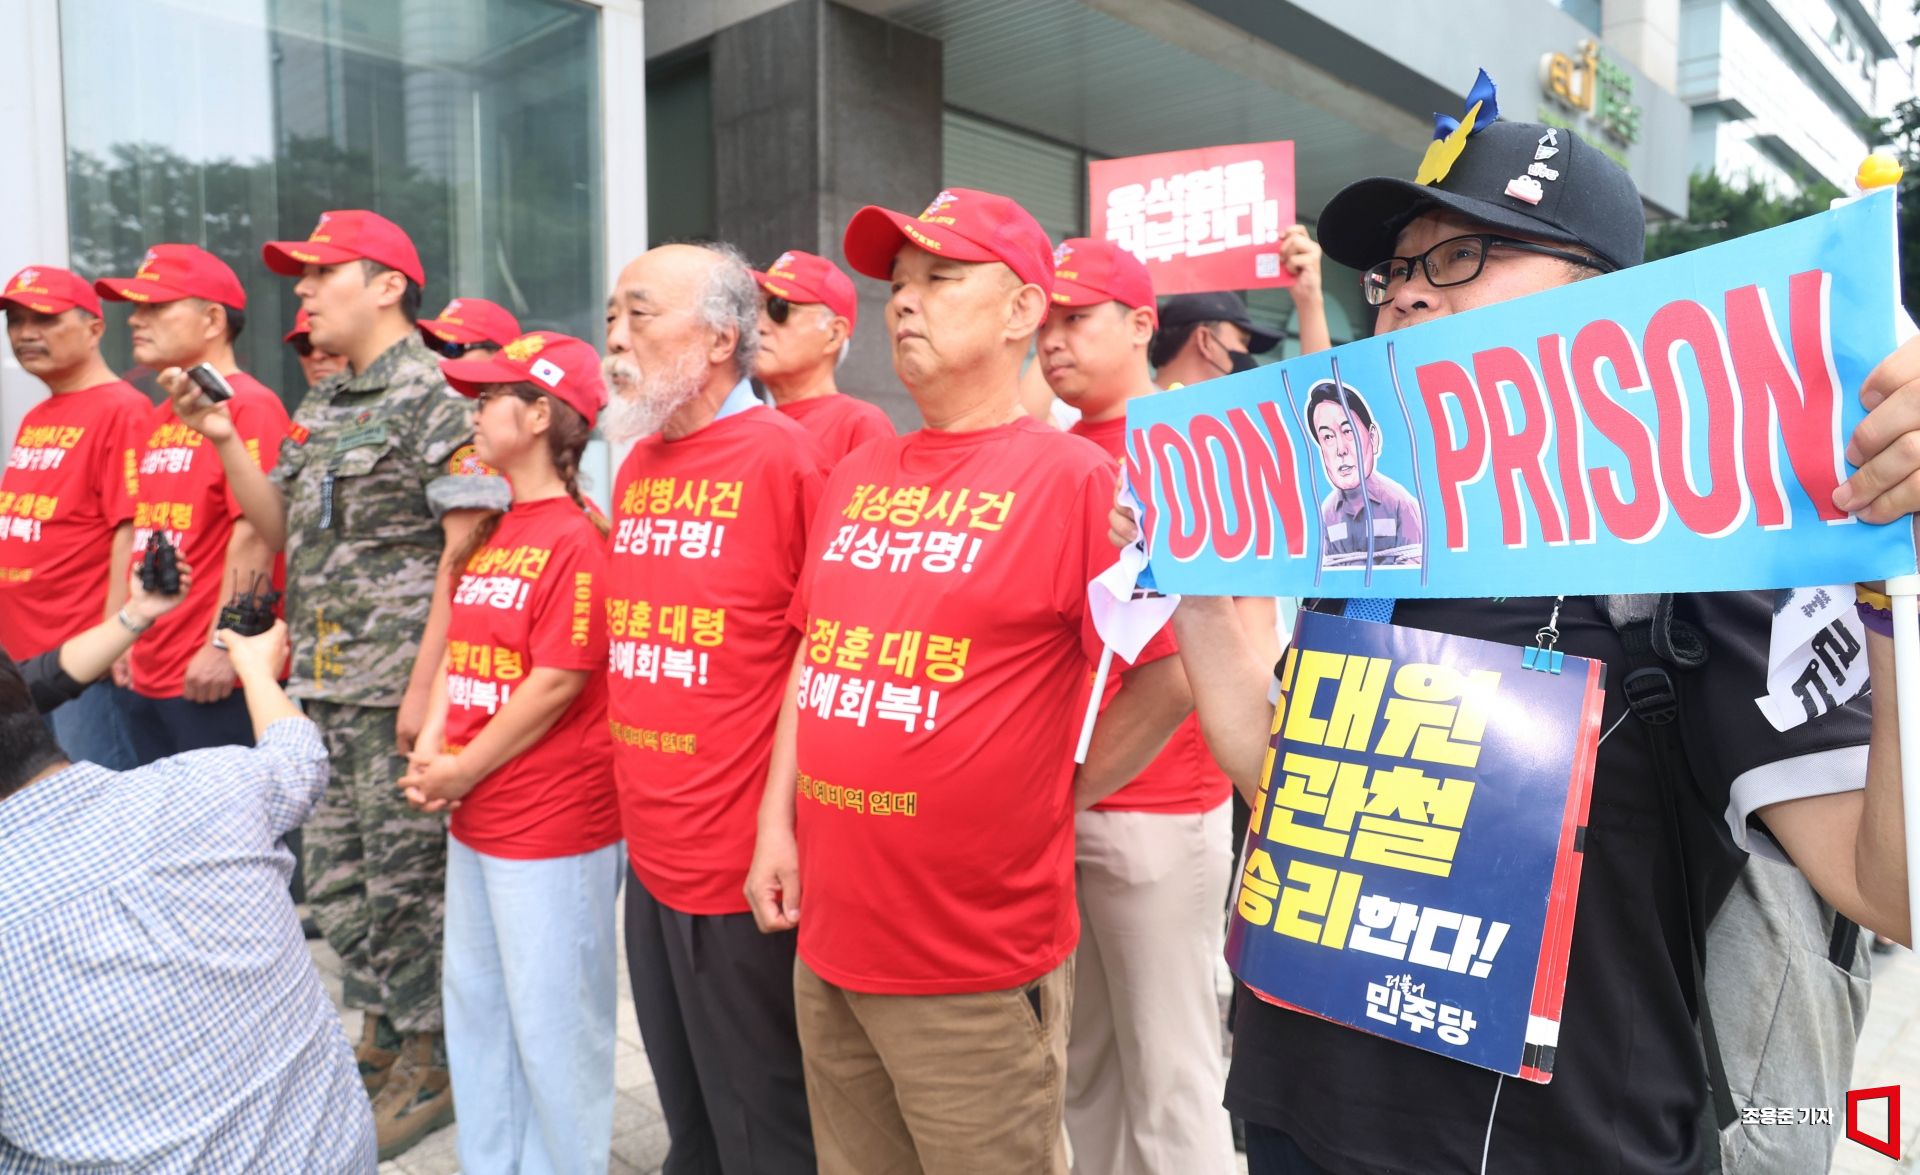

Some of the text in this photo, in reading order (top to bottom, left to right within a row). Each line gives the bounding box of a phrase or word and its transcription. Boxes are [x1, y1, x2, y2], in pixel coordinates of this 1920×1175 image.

[1126, 268, 1857, 562] YOON PRISON
[613, 517, 725, 559] 진상규명!
[822, 523, 983, 573] 진상규명!
[570, 571, 593, 647] ROKMC
[658, 605, 725, 646] 대령
[806, 614, 972, 683] 정훈 대령
[812, 780, 864, 814] 예비역
[868, 791, 917, 816] 연대
[1238, 847, 1511, 979] 승리한다!
[1366, 982, 1478, 1046] 민주당
[1384, 973, 1426, 998] 더불어
